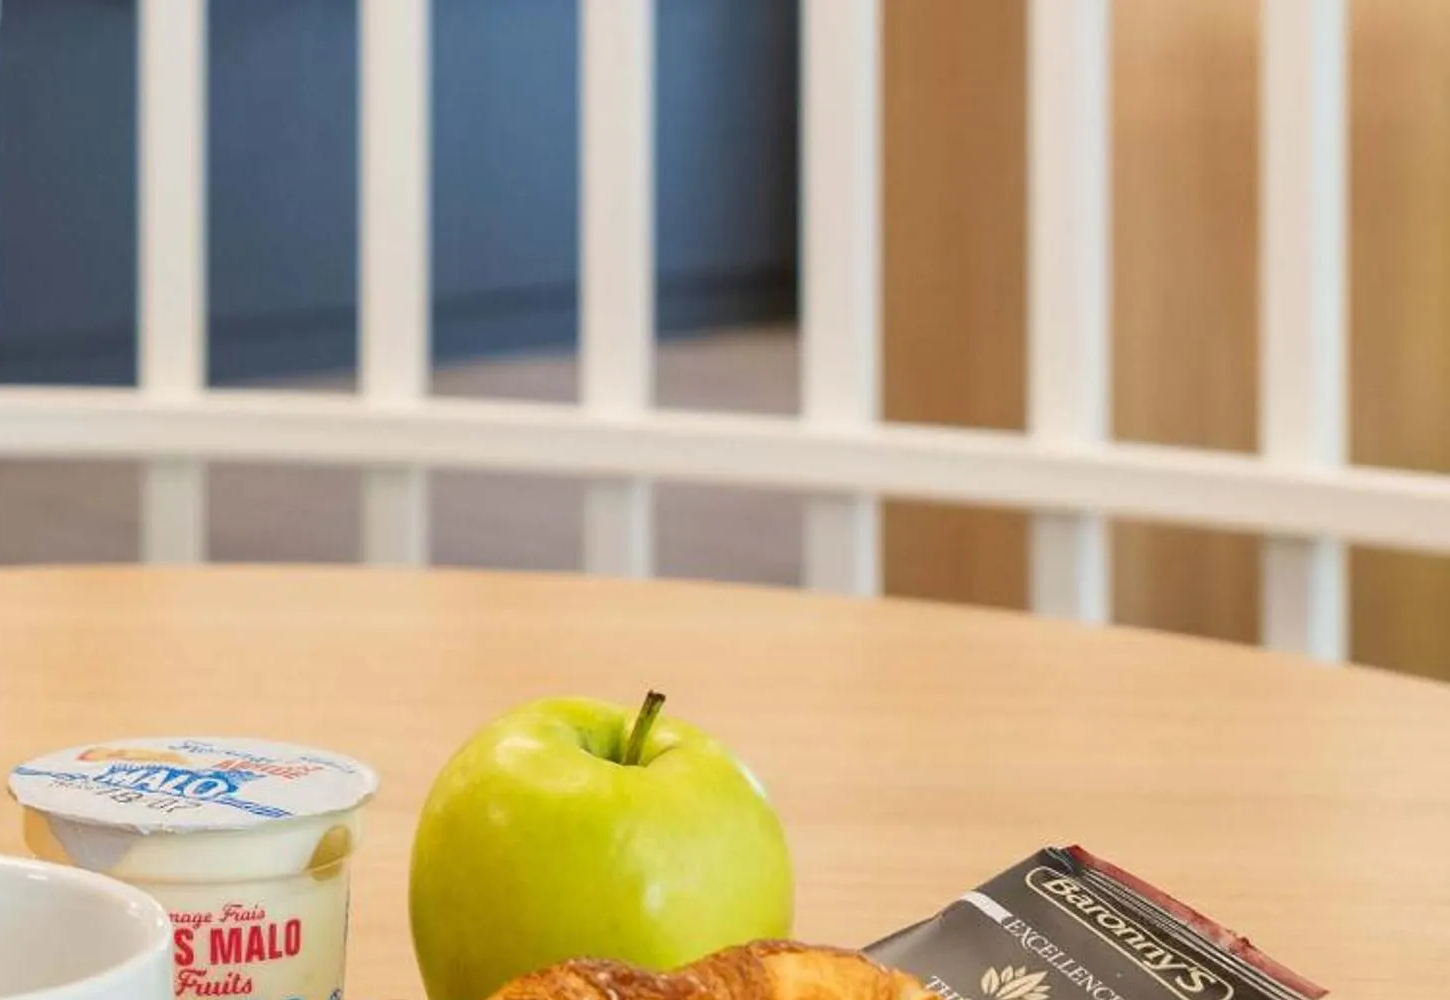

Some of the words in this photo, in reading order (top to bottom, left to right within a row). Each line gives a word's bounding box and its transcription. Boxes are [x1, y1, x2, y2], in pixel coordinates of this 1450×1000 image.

[99, 767, 225, 801] MALO
[218, 902, 266, 923] Frais
[210, 917, 302, 966] MALO
[174, 967, 254, 998] Fruits
